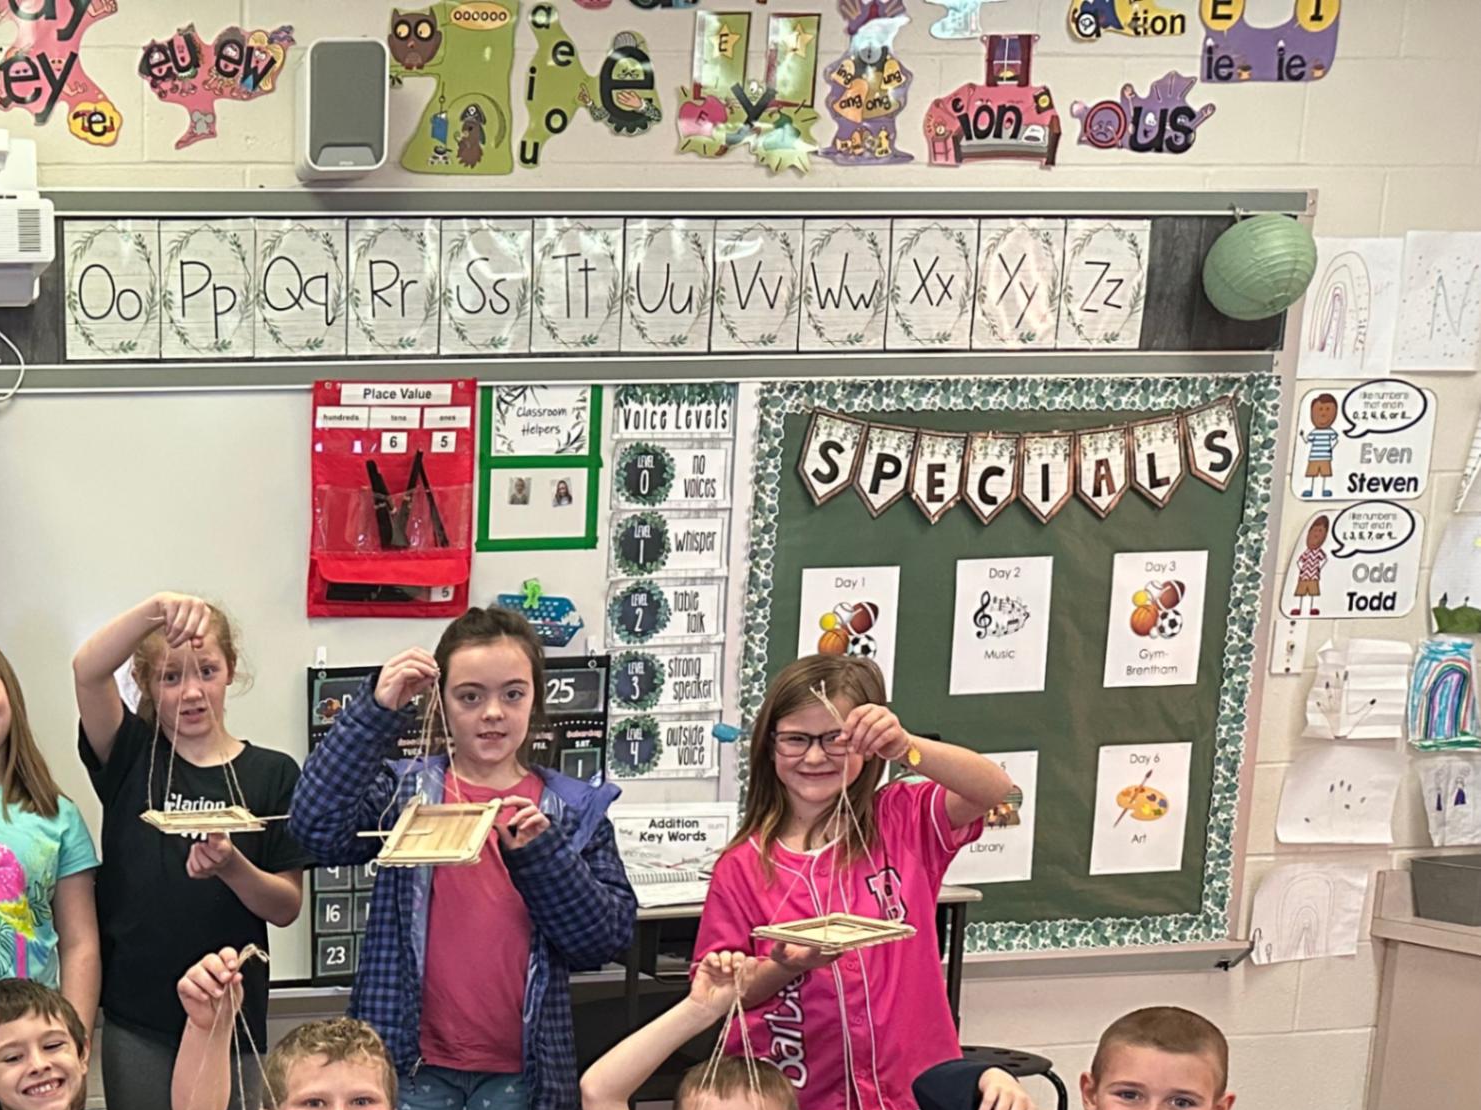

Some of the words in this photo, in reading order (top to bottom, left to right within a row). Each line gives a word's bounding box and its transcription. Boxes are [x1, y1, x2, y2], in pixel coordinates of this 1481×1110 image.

[531, 5, 553, 29] a
[552, 41, 574, 67] e
[527, 66, 537, 101] i
[838, 91, 863, 110] ang
[865, 91, 892, 112] ong
[545, 108, 568, 134] o
[953, 97, 1022, 141] ion
[519, 140, 540, 165] u
[79, 263, 144, 322] Oo
[262, 254, 337, 328] Qq
[369, 259, 418, 320] Rr
[456, 256, 511, 316] Ss
[551, 252, 598, 320] Tt
[635, 261, 695, 317] Uu
[730, 259, 785, 311] Vv
[811, 253, 879, 312] Ww
[911, 256, 955, 308] Xx
[998, 252, 1040, 329] Yy
[1081, 261, 1125, 314] Zz
[180, 260, 237, 341] Pp
[363, 388, 396, 400] Place
[400, 388, 432, 400] Value
[516, 406, 568, 419] Classroom
[521, 423, 561, 437] Helpers
[389, 436, 397, 448] 6
[440, 436, 448, 448] 5
[1360, 443, 1412, 464] Even
[692, 455, 705, 474] no
[812, 429, 1233, 505] SPECIALS
[684, 478, 716, 498] voices
[1347, 473, 1419, 493] Steven
[674, 530, 717, 554] whisper
[989, 567, 1011, 580] Day
[1014, 567, 1021, 577] 2
[1145, 561, 1166, 574] Day
[1169, 561, 1177, 571] 3
[1352, 563, 1398, 583] Odd
[835, 577, 860, 590] Day
[674, 590, 699, 611] table
[1346, 591, 1397, 612] Todd
[635, 609, 643, 632] 2
[687, 612, 705, 633] talk
[984, 648, 1016, 661] Music
[1139, 649, 1169, 662] Gym-
[668, 657, 701, 679] strong
[1126, 664, 1178, 676] Brentham
[631, 676, 640, 700] 3
[673, 679, 713, 702] speaker
[667, 725, 704, 747] outside
[630, 741, 639, 765] 4
[678, 746, 704, 765] voice
[1129, 754, 1151, 765] Day
[1153, 754, 1160, 763] 6
[648, 818, 699, 829] Addition
[639, 831, 663, 844] Key
[668, 831, 707, 841] Words
[970, 843, 1005, 853] Library
[1131, 834, 1147, 844] Art
[326, 904, 340, 922] 16
[326, 946, 345, 964] 23
